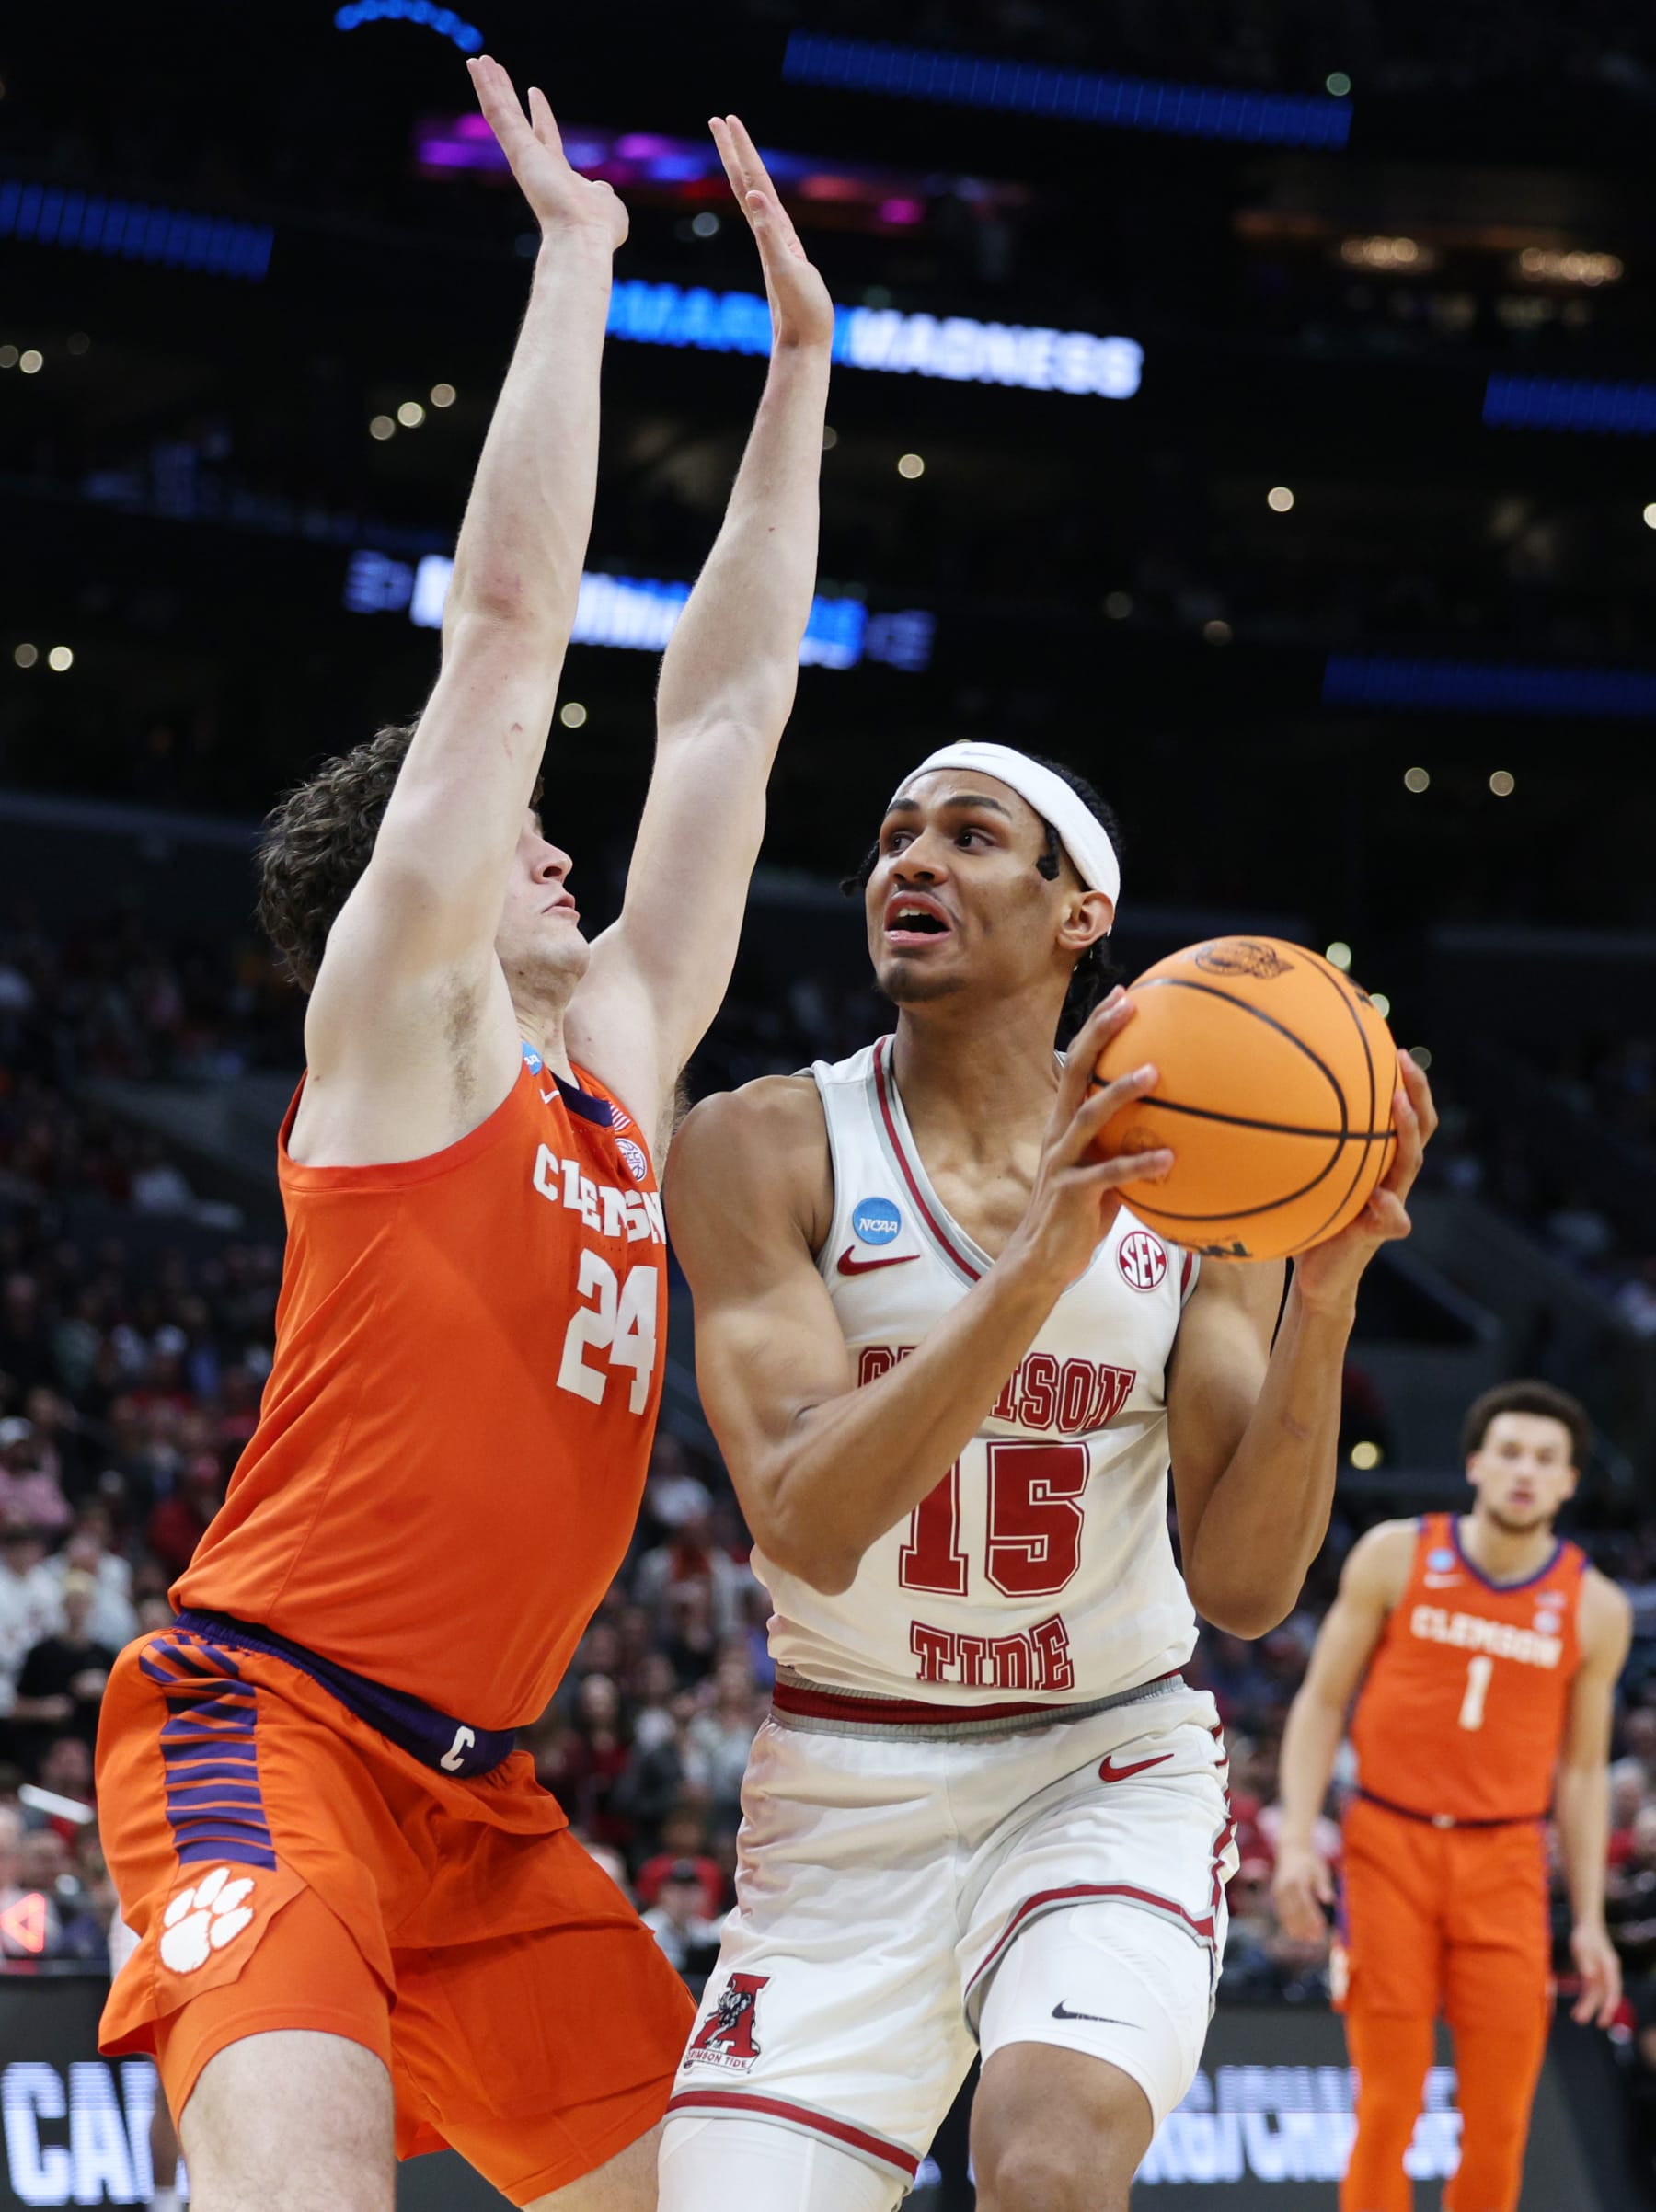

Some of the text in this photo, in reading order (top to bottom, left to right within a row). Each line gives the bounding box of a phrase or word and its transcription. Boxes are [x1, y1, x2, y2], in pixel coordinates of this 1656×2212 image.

[858, 1217, 898, 1233] NCAA
[1120, 1232, 1167, 1288] SEC
[556, 1247, 658, 1415] 24
[857, 1346, 1137, 1433] CSON
[899, 1440, 1090, 1598] 15
[910, 1613, 1075, 1691] TIDE
[1410, 1604, 1563, 1669] CLEMSON
[1458, 1655, 1494, 1731] 1
[440, 1725, 476, 1771] C
